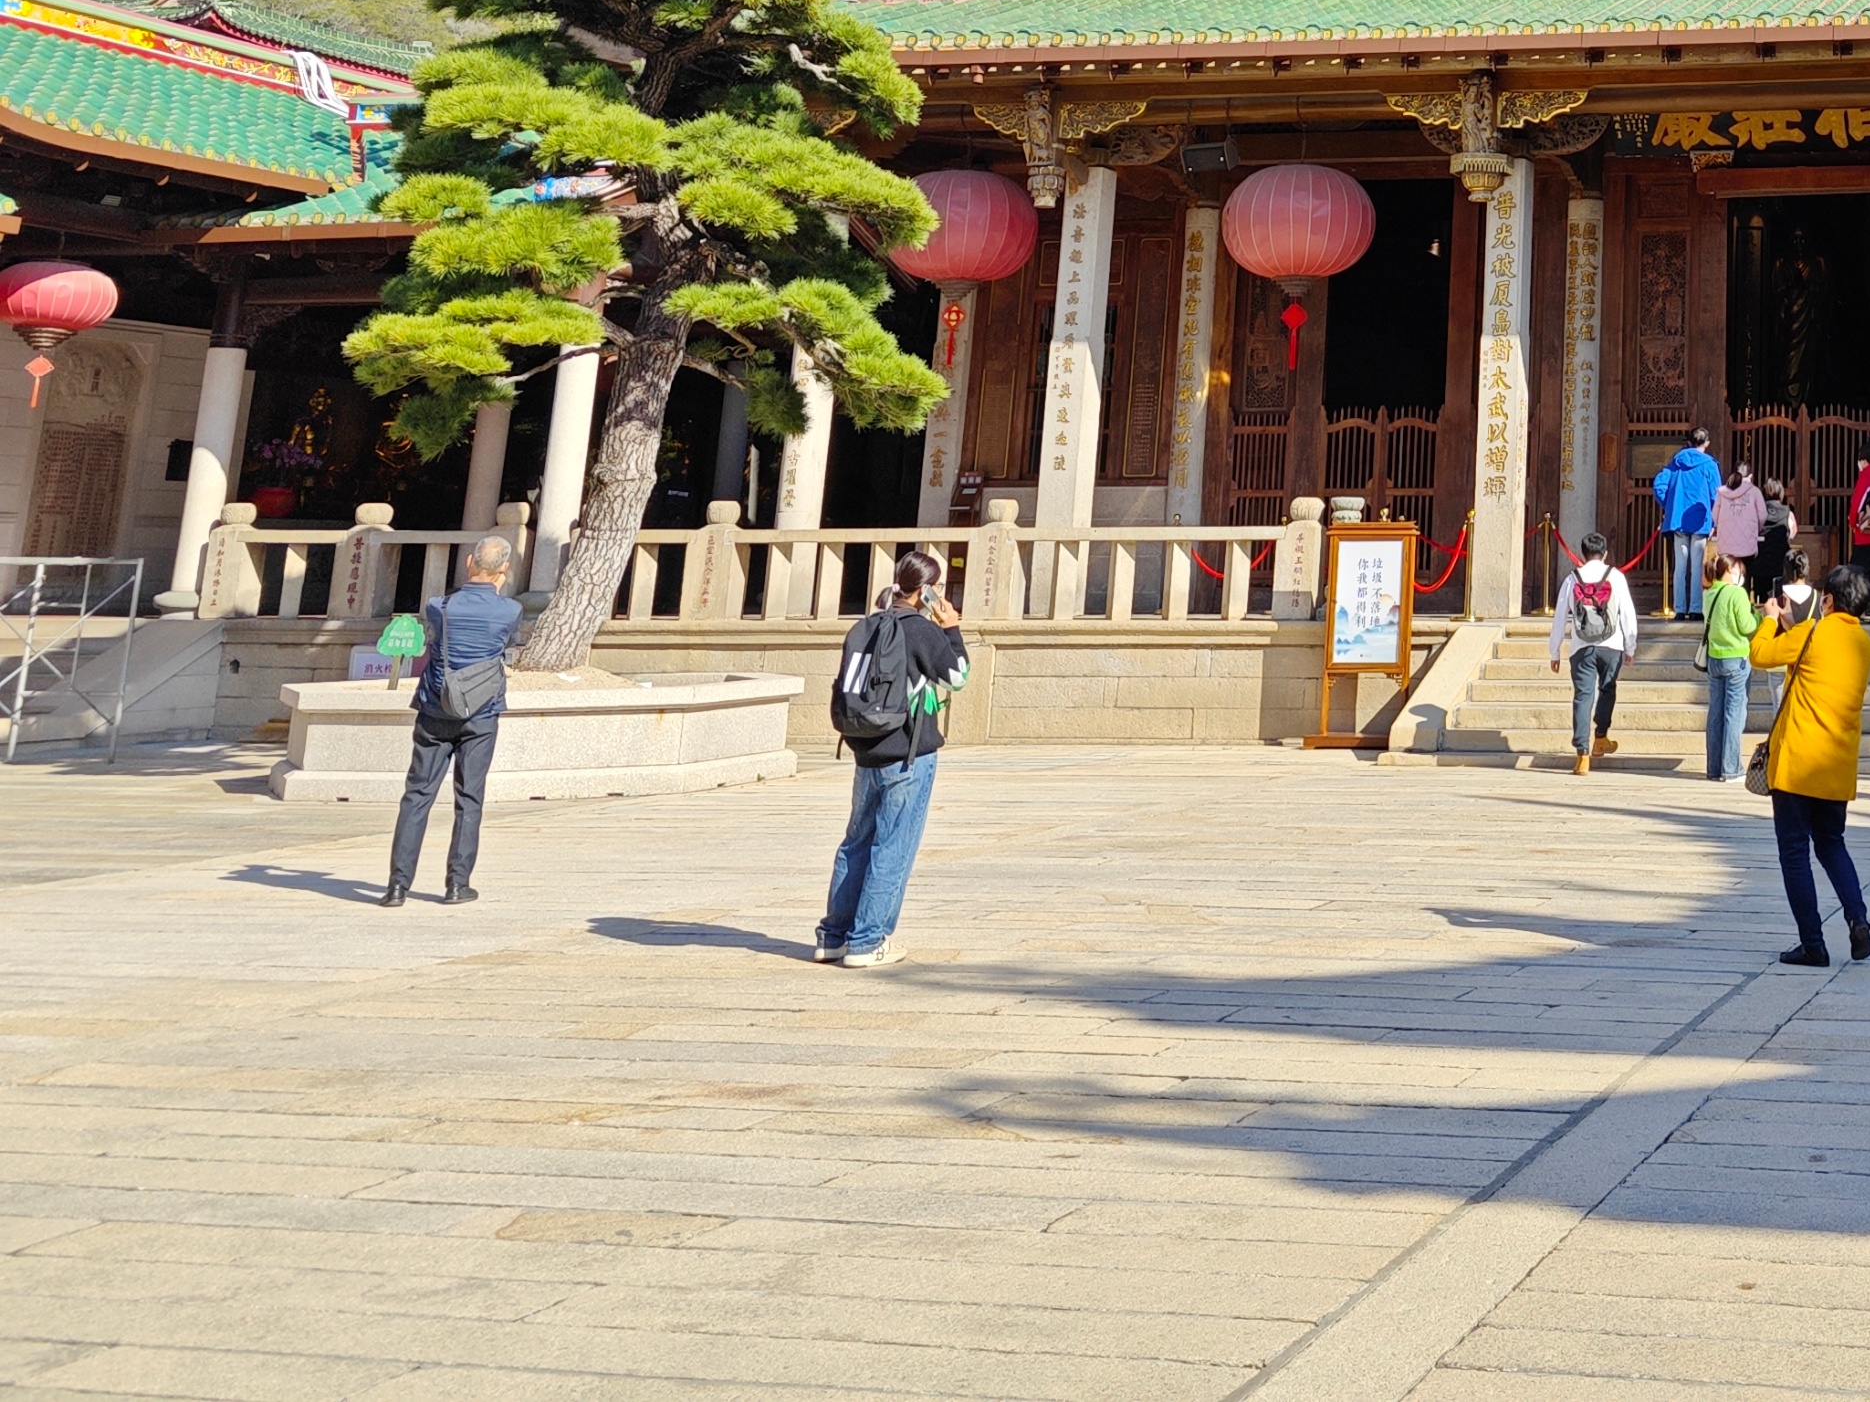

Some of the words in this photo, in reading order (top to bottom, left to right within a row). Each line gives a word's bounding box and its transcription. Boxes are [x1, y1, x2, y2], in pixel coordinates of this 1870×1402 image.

[1355, 558, 1369, 629] 你我都得利
[1370, 558, 1384, 628] 垃圾不落地
